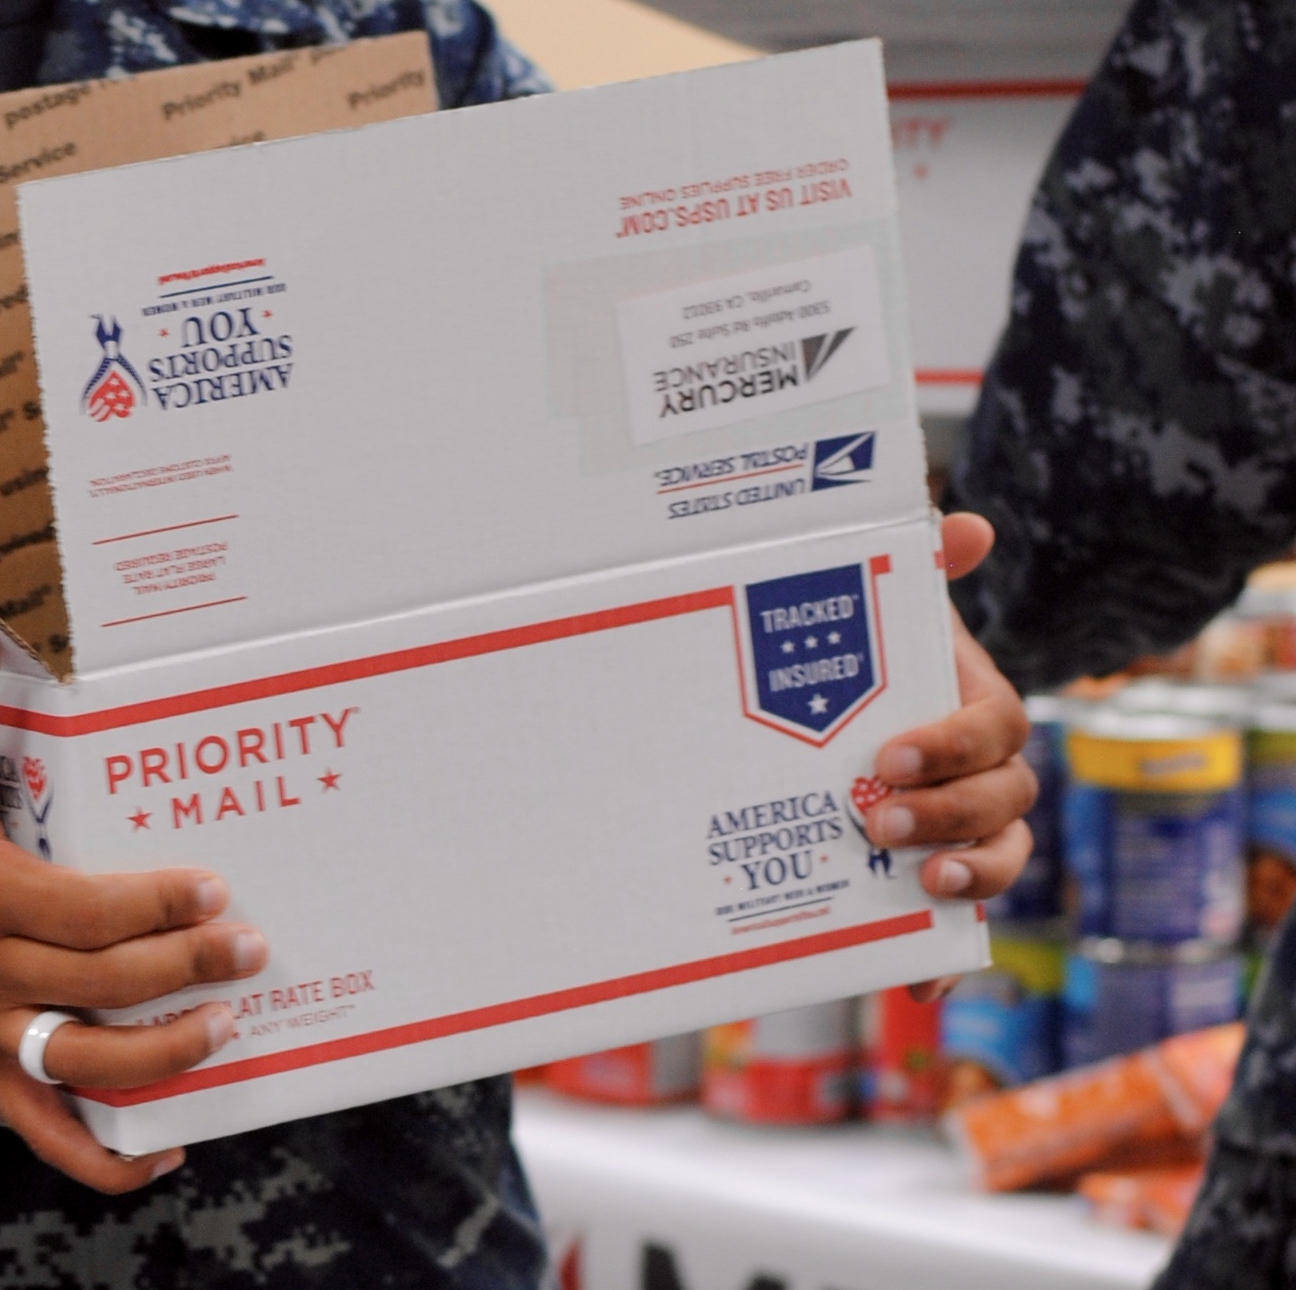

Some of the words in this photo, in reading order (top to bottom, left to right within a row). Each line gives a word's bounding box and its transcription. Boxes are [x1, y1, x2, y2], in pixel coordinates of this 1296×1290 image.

[6, 83, 92, 129] postage
[162, 78, 242, 120] Priority
[346, 69, 425, 111] Priority
[618, 188, 677, 210] ONLINE
[680, 175, 750, 199] SUPPLIES
[735, 192, 760, 217] AT
[765, 187, 794, 211] US
[799, 178, 853, 206] VISIT
[181, 307, 260, 348] YOU
[148, 334, 294, 382] SUPPORTS
[652, 340, 797, 392] INSURANCE
[152, 362, 295, 411] AMERICA
[658, 365, 800, 419] MERCURY
[740, 442, 810, 473] POSTAL
[0, 466, 49, 497] usin
[735, 478, 807, 507] UNITED
[667, 488, 733, 521] STATES
[760, 594, 855, 634] TRACKED
[768, 653, 861, 692] INSURED
[104, 707, 354, 795] PRIORITY
[170, 774, 302, 830] MAIL
[705, 790, 840, 840] AMERICA
[708, 816, 845, 867] SUPPORTS
[740, 850, 815, 892] YOU
[271, 980, 324, 1008] RATE
[330, 970, 377, 1000] BOX
